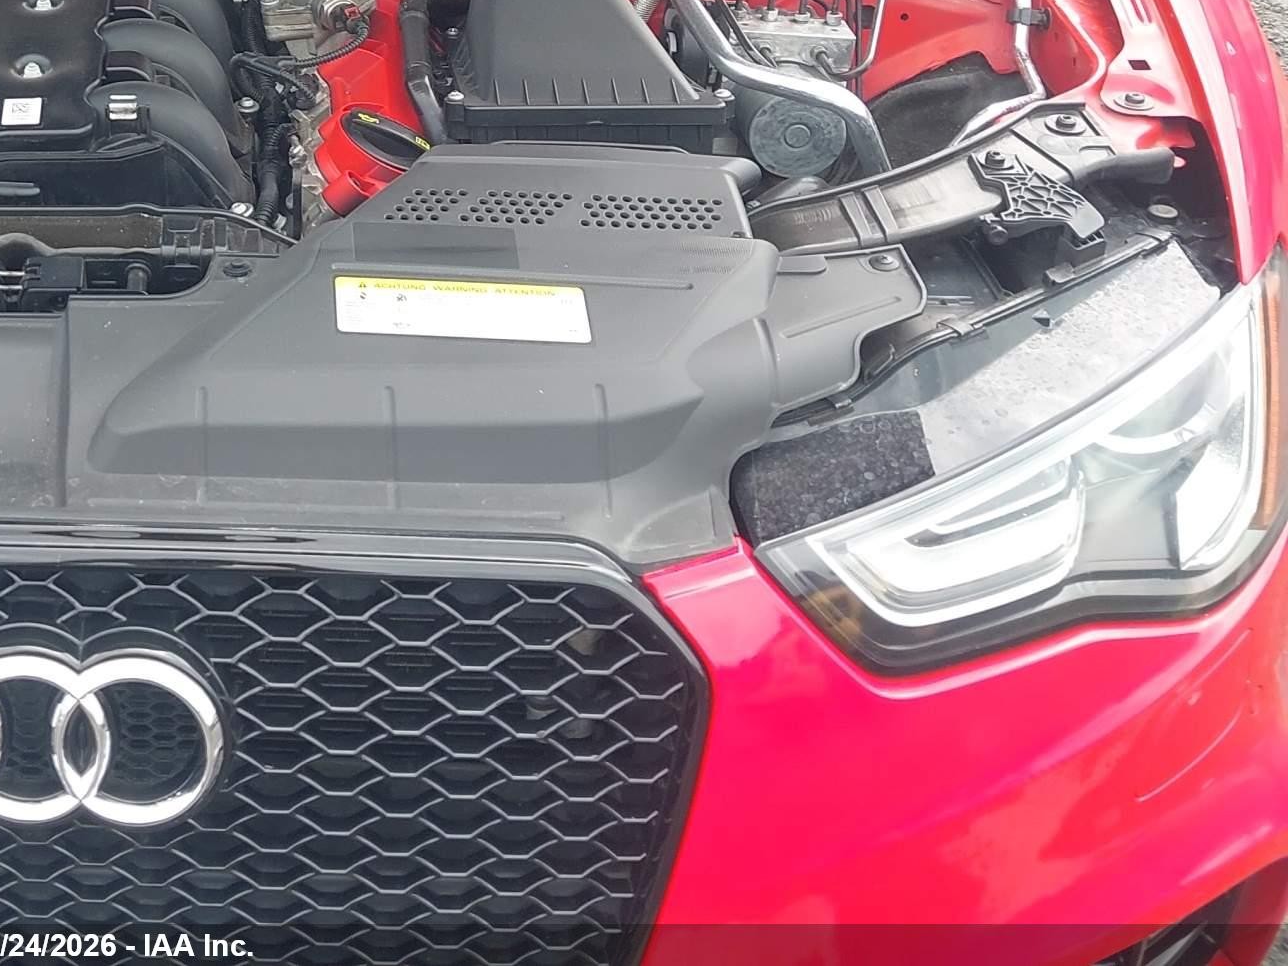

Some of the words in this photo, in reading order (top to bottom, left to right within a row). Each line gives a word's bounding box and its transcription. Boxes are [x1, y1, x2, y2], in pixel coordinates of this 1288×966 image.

[373, 282, 426, 292] ACHTUNG
[433, 284, 488, 294] WARNING
[495, 287, 556, 297] ATTENTION
